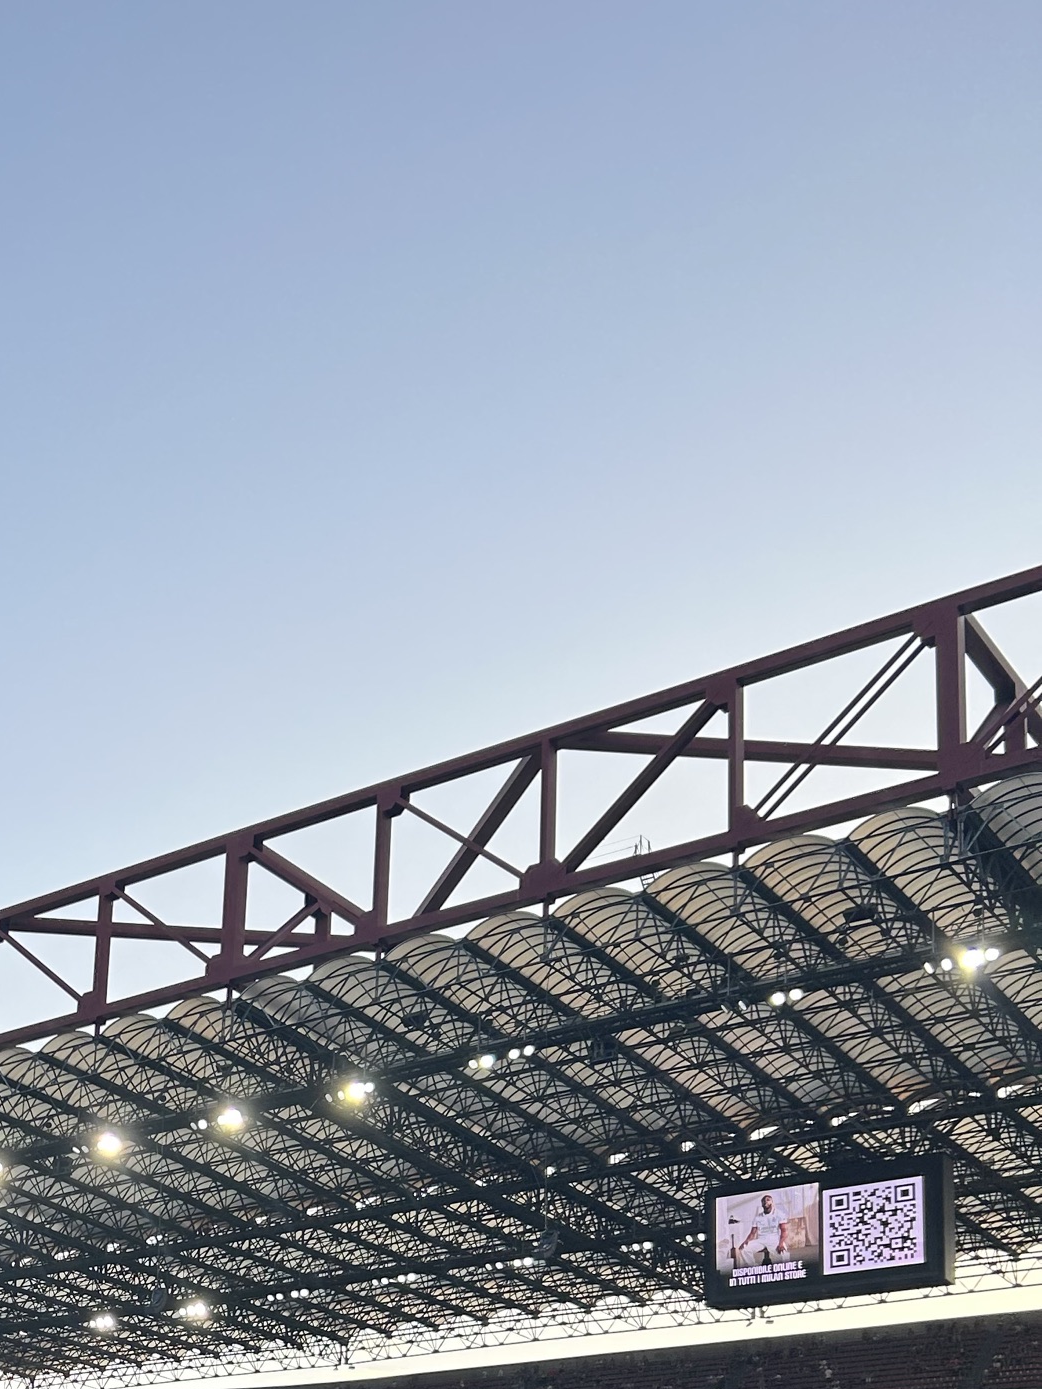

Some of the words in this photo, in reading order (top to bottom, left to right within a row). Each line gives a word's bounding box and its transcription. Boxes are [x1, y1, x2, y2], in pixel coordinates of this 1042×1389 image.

[733, 1265, 772, 1277] DISPONIBILE
[773, 1261, 797, 1272] ONLINE
[738, 1275, 756, 1286] TUTTI
[761, 1272, 784, 1283] MILAN
[784, 1269, 807, 1280] STORE
